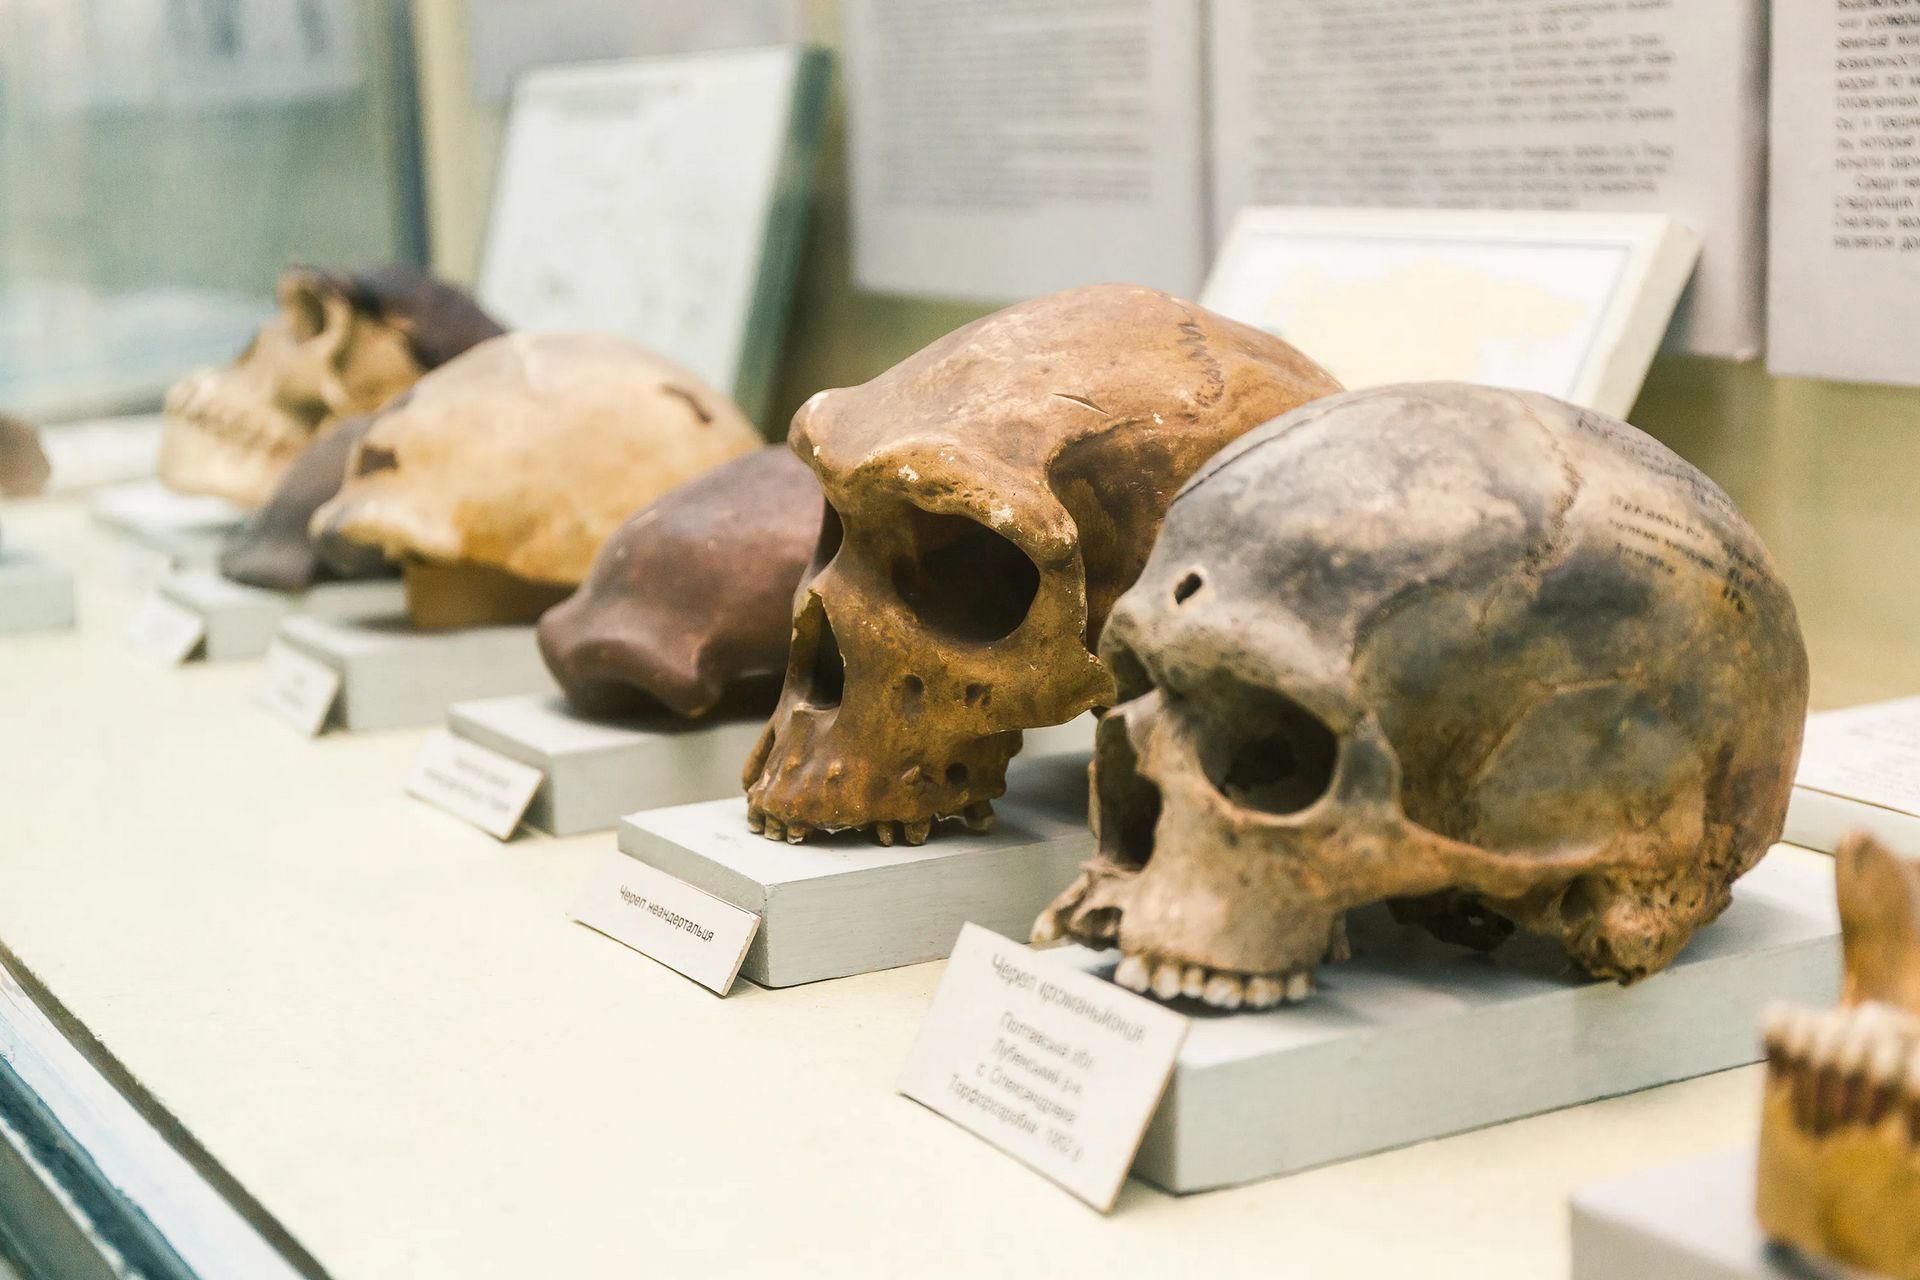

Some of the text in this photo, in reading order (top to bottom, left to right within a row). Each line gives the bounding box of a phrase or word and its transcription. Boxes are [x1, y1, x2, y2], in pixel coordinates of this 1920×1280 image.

[620, 884, 715, 943] Череп неандертальця
[992, 952, 1037, 989] Череп
